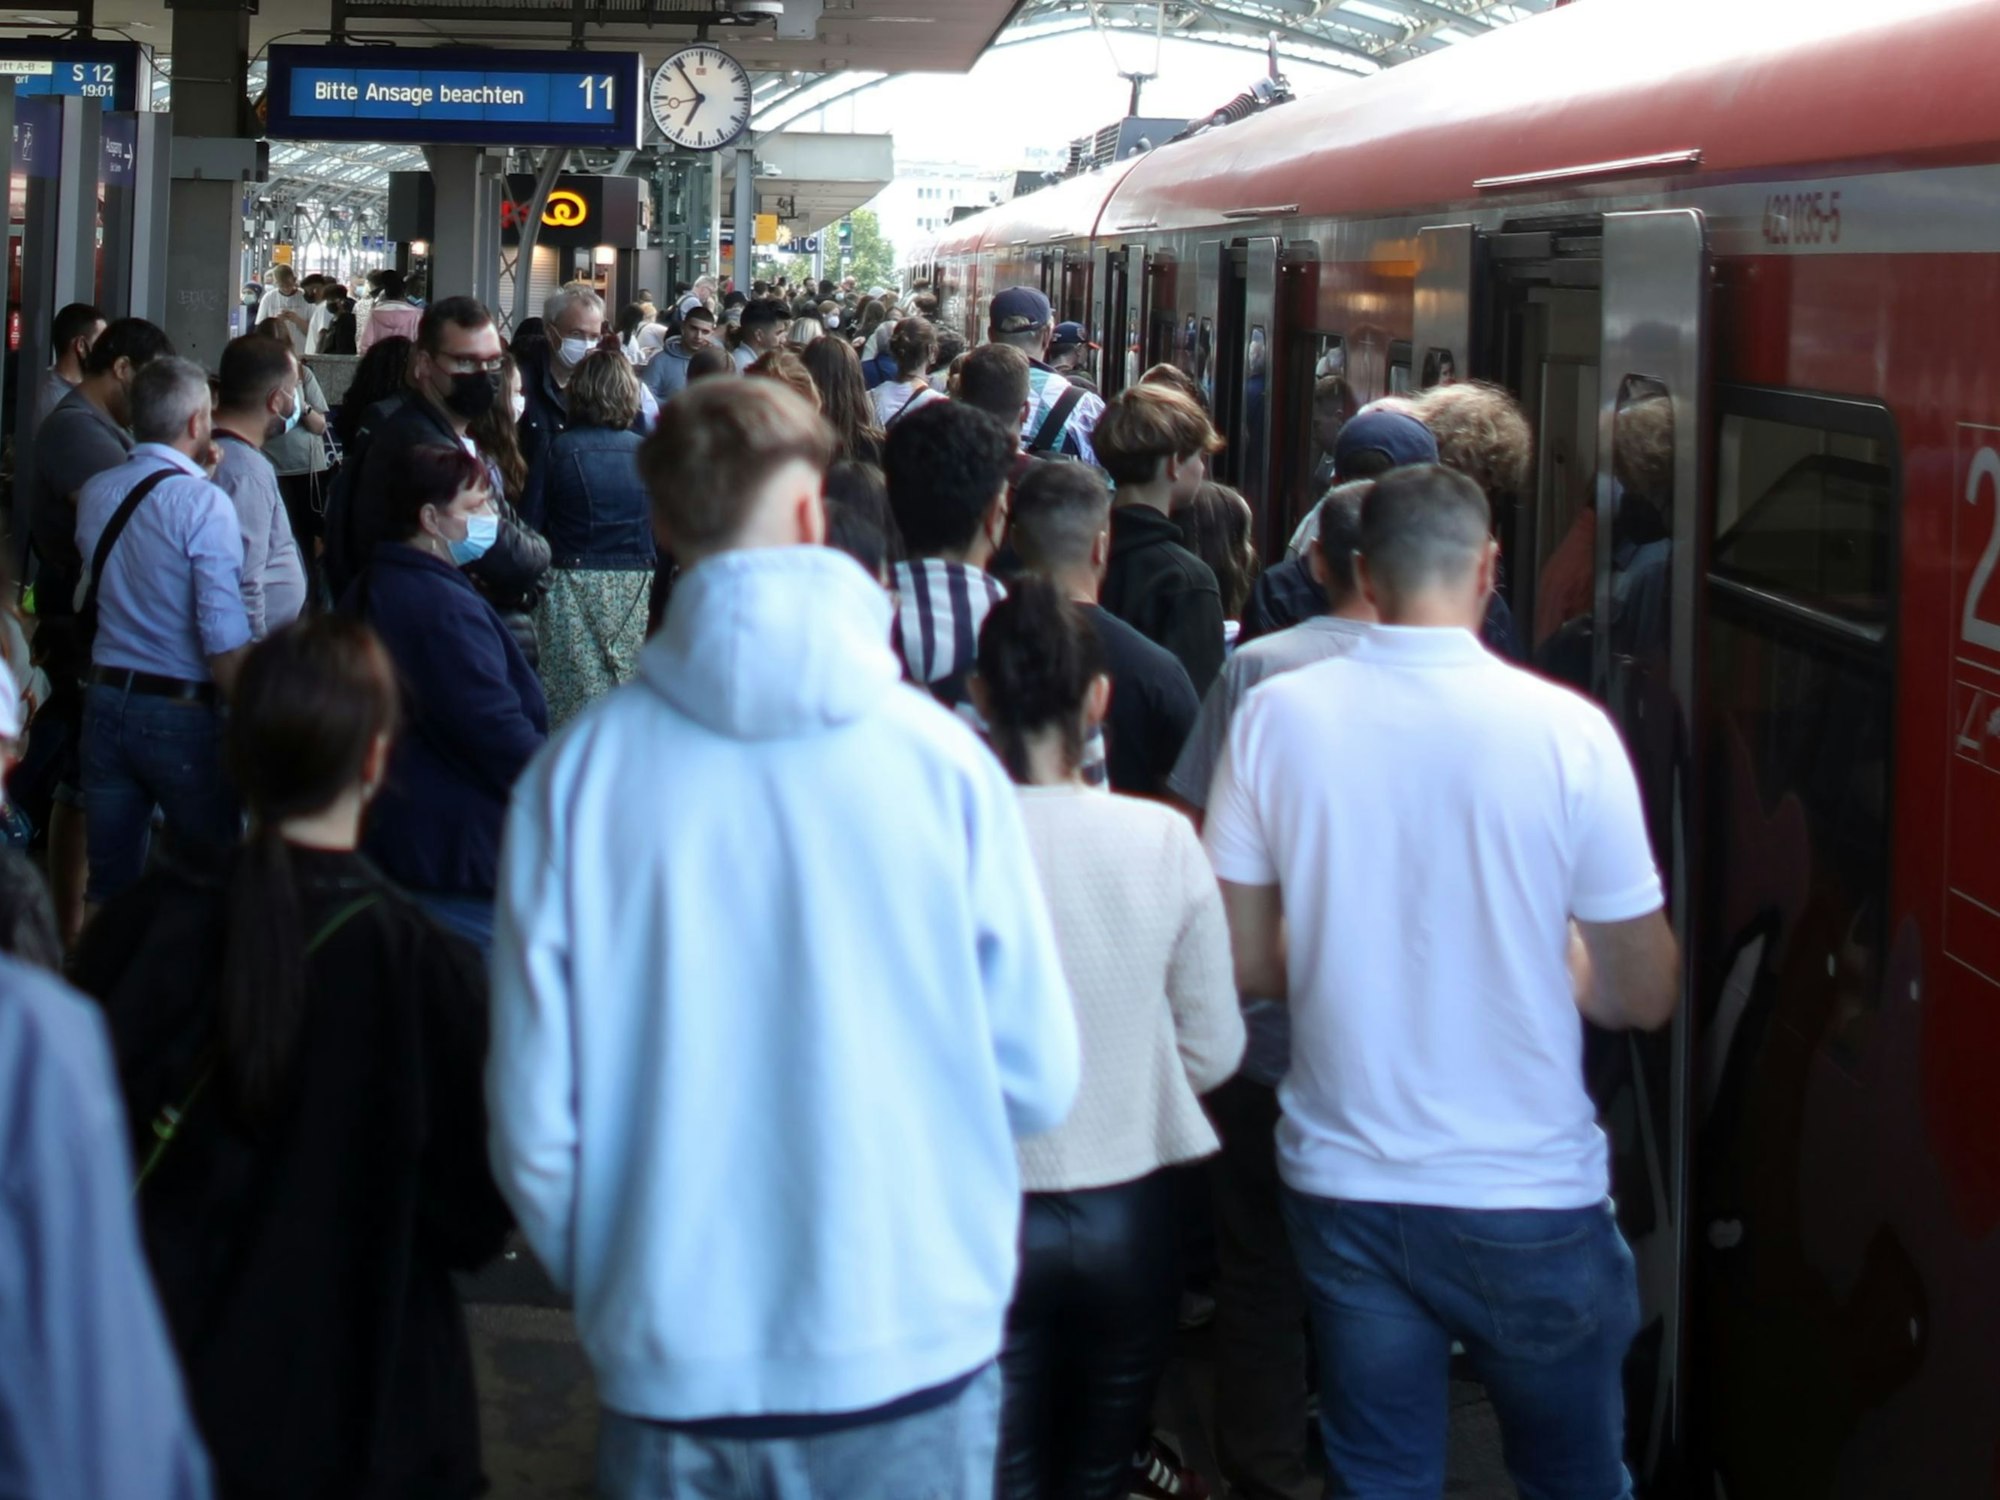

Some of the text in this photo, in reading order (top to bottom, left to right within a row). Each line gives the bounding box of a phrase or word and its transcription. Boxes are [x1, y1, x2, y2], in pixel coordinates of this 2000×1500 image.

[73, 64, 114, 82] S 12
[81, 85, 113, 97] 19:01
[315, 81, 524, 107] Bitte Ansage beachten
[578, 75, 614, 110] 11
[805, 237, 817, 252] C
